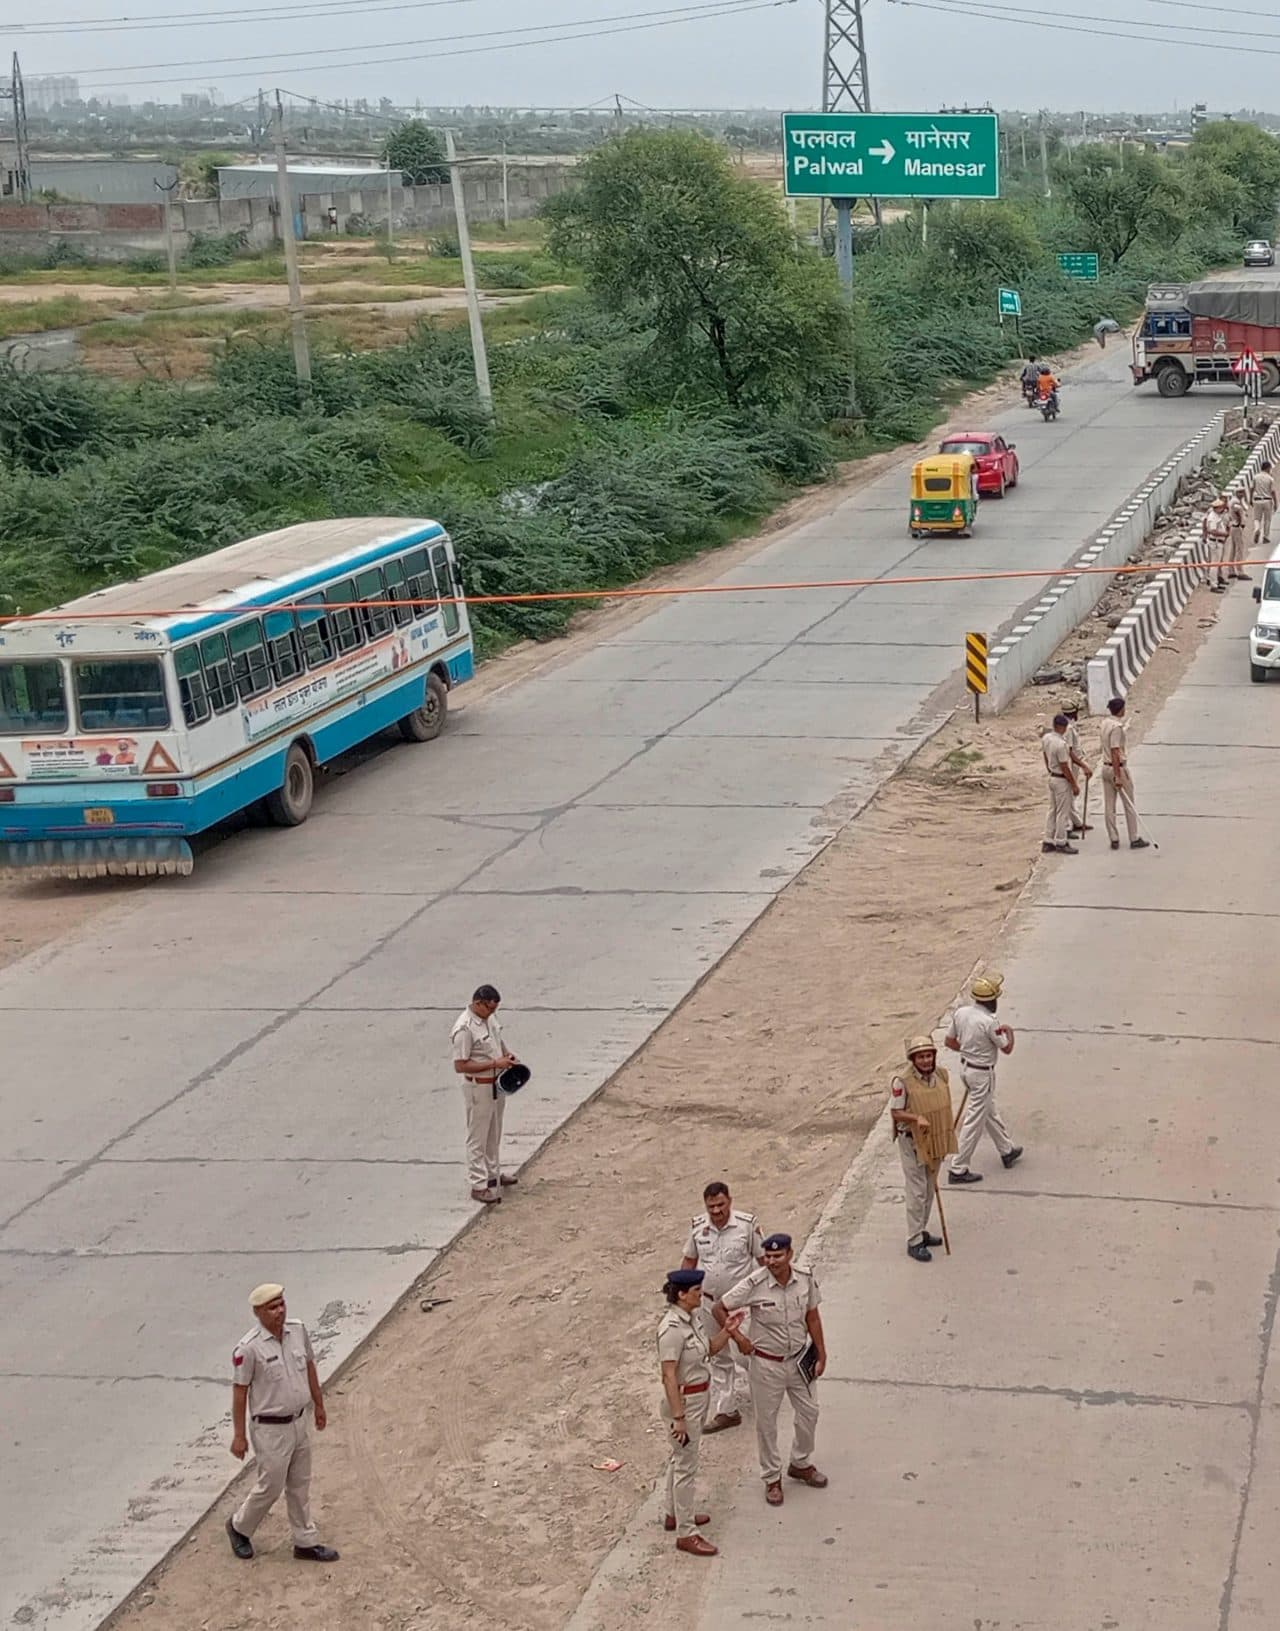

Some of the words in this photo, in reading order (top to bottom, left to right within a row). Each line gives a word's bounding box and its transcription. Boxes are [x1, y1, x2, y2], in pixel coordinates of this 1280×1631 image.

[790, 130, 856, 149] पलवल
[905, 124, 971, 149] मानेसर
[794, 156, 863, 176] Palwal
[905, 158, 986, 177] Manesar
